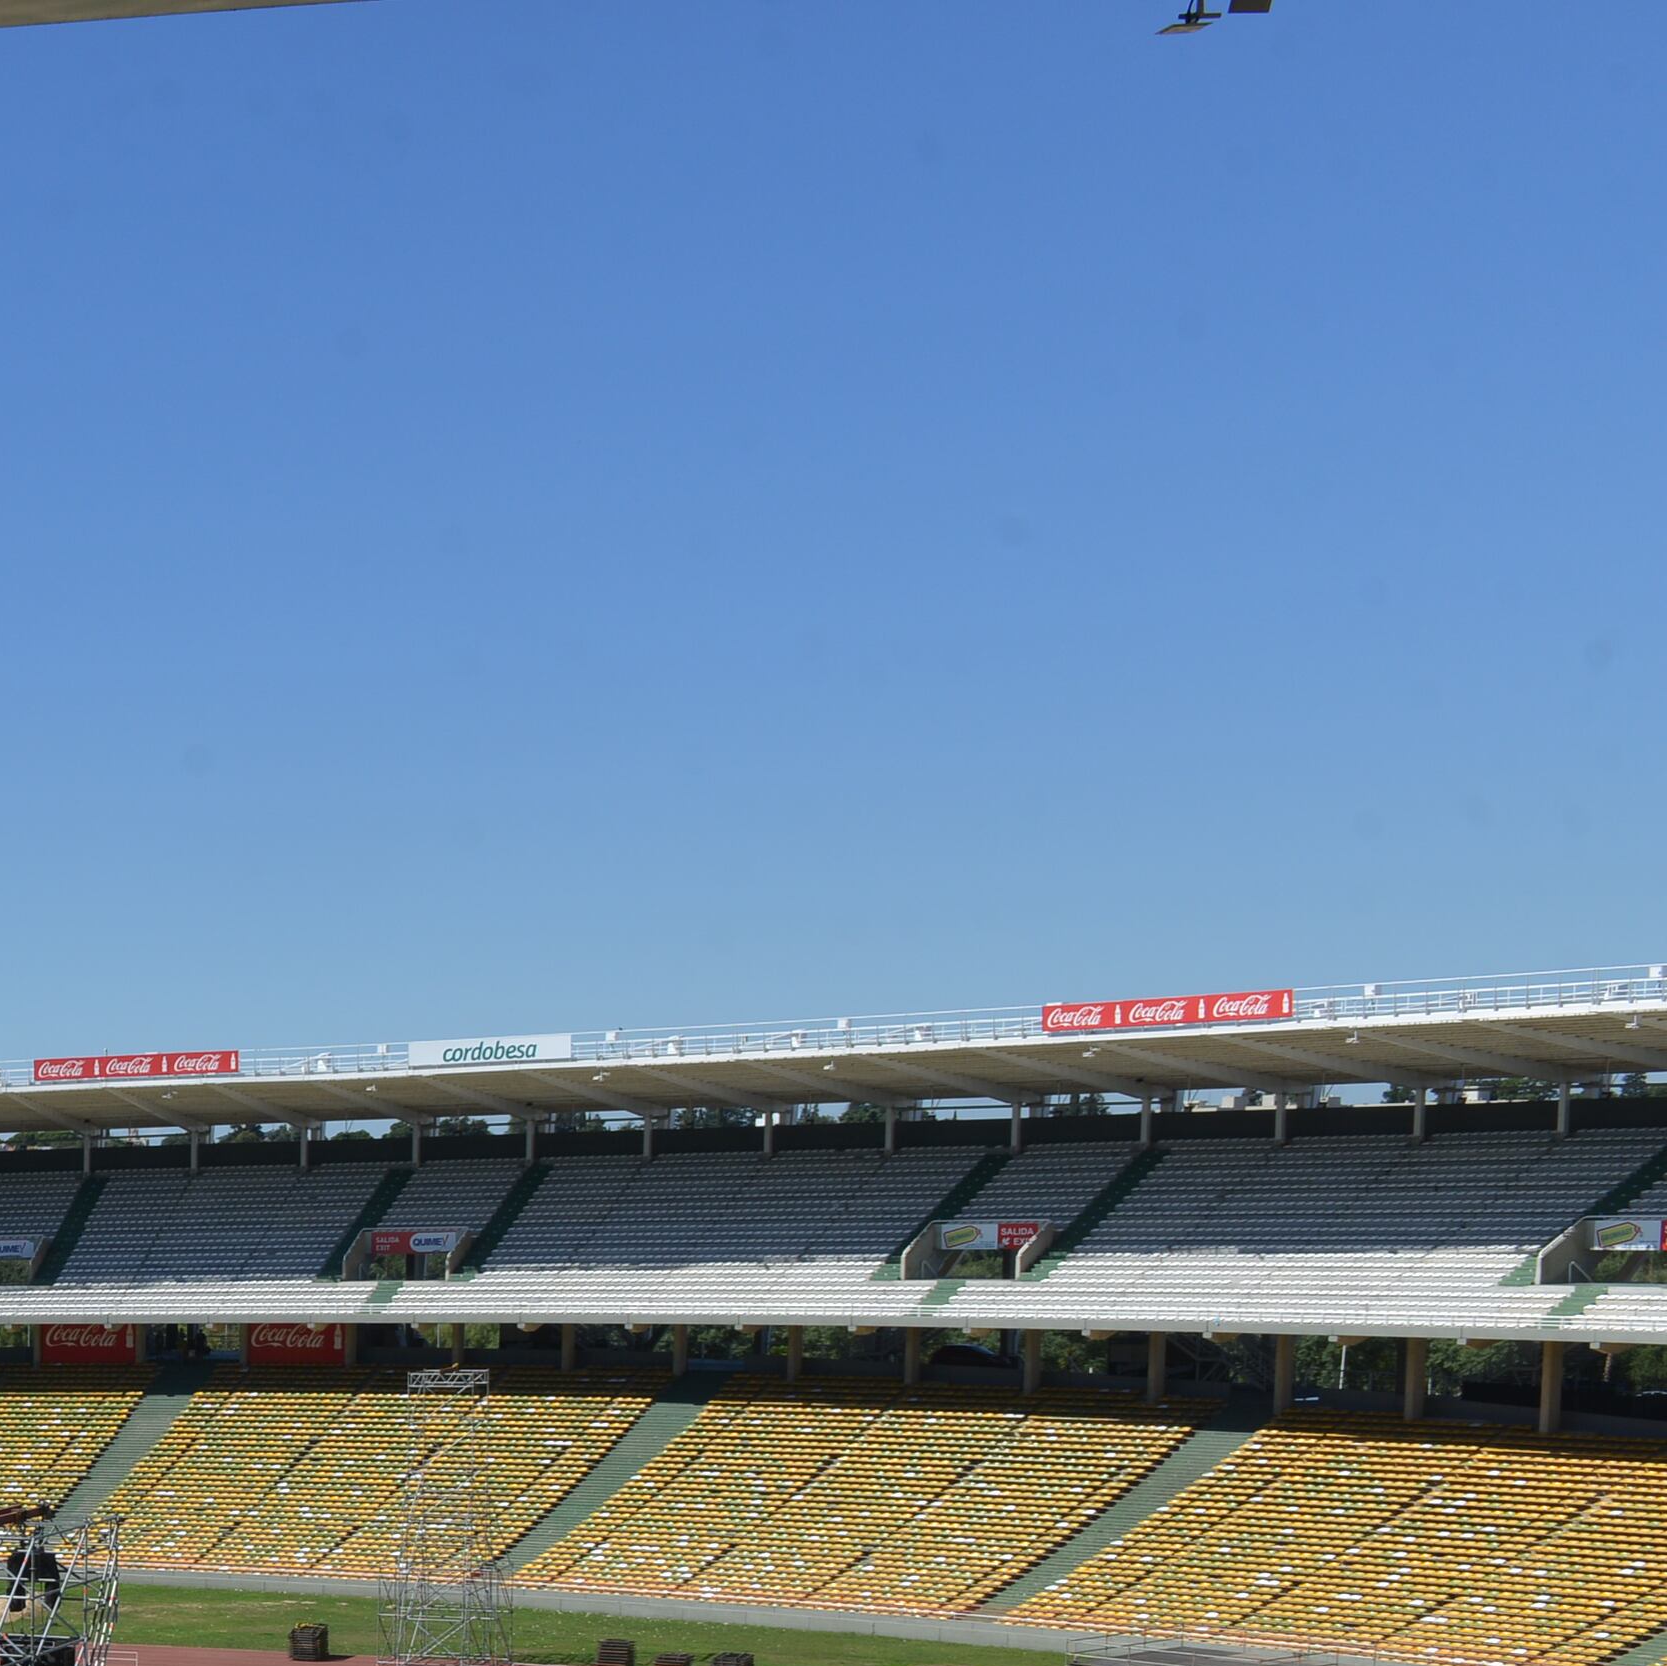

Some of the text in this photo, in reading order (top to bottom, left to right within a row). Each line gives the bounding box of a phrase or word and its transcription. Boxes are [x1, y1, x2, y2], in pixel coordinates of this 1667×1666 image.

[1129, 1000, 1187, 1022] Coca-Cola
[1212, 994, 1271, 1017] Coca-Cola
[1047, 1006, 1104, 1028] Coca-Cola
[443, 1041, 537, 1062] cordobesa
[38, 1059, 86, 1077] Coca-Cola
[106, 1057, 154, 1075] Coca-Cola
[174, 1054, 222, 1072] Coca-Cola
[1001, 1227, 1034, 1236] SALIDA
[1013, 1237, 1032, 1246] EXI
